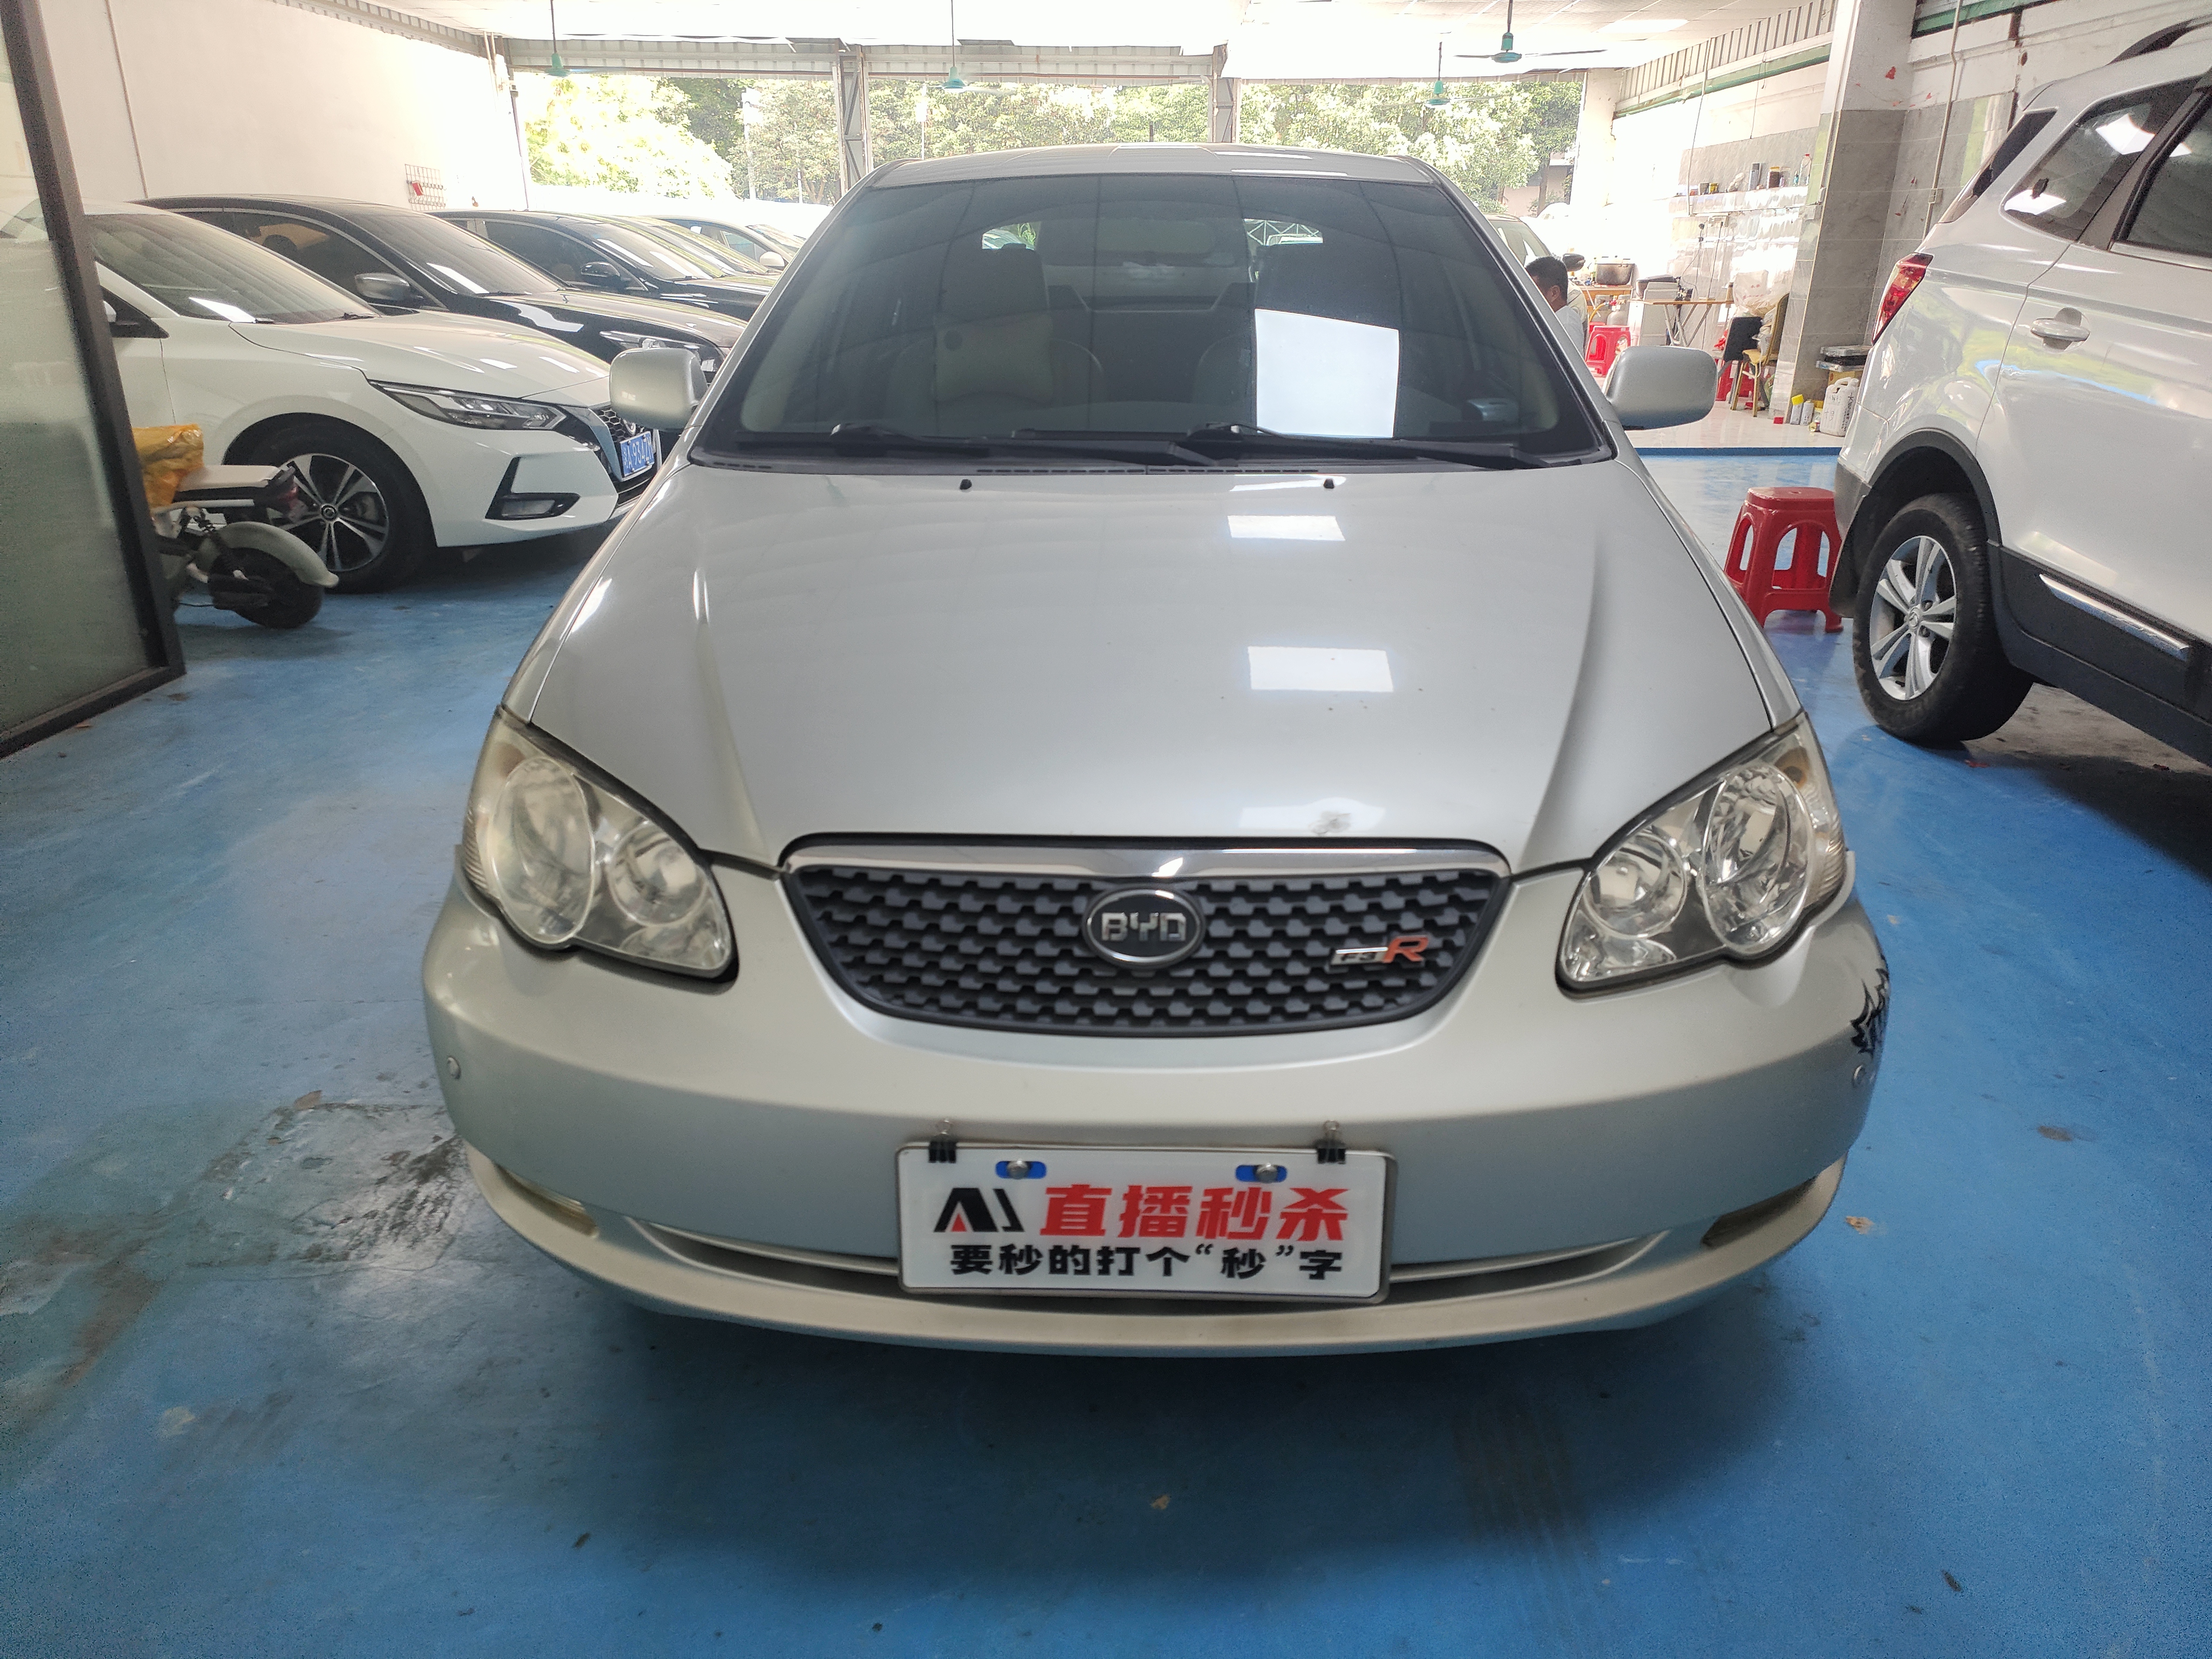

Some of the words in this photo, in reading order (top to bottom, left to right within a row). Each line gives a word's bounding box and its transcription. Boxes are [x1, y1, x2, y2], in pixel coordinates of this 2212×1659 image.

[1102, 912, 1186, 941] BYD
[1040, 1183, 1348, 1241] 直播秒杀
[950, 1243, 1343, 1280] 要秒的打个“秒”字
